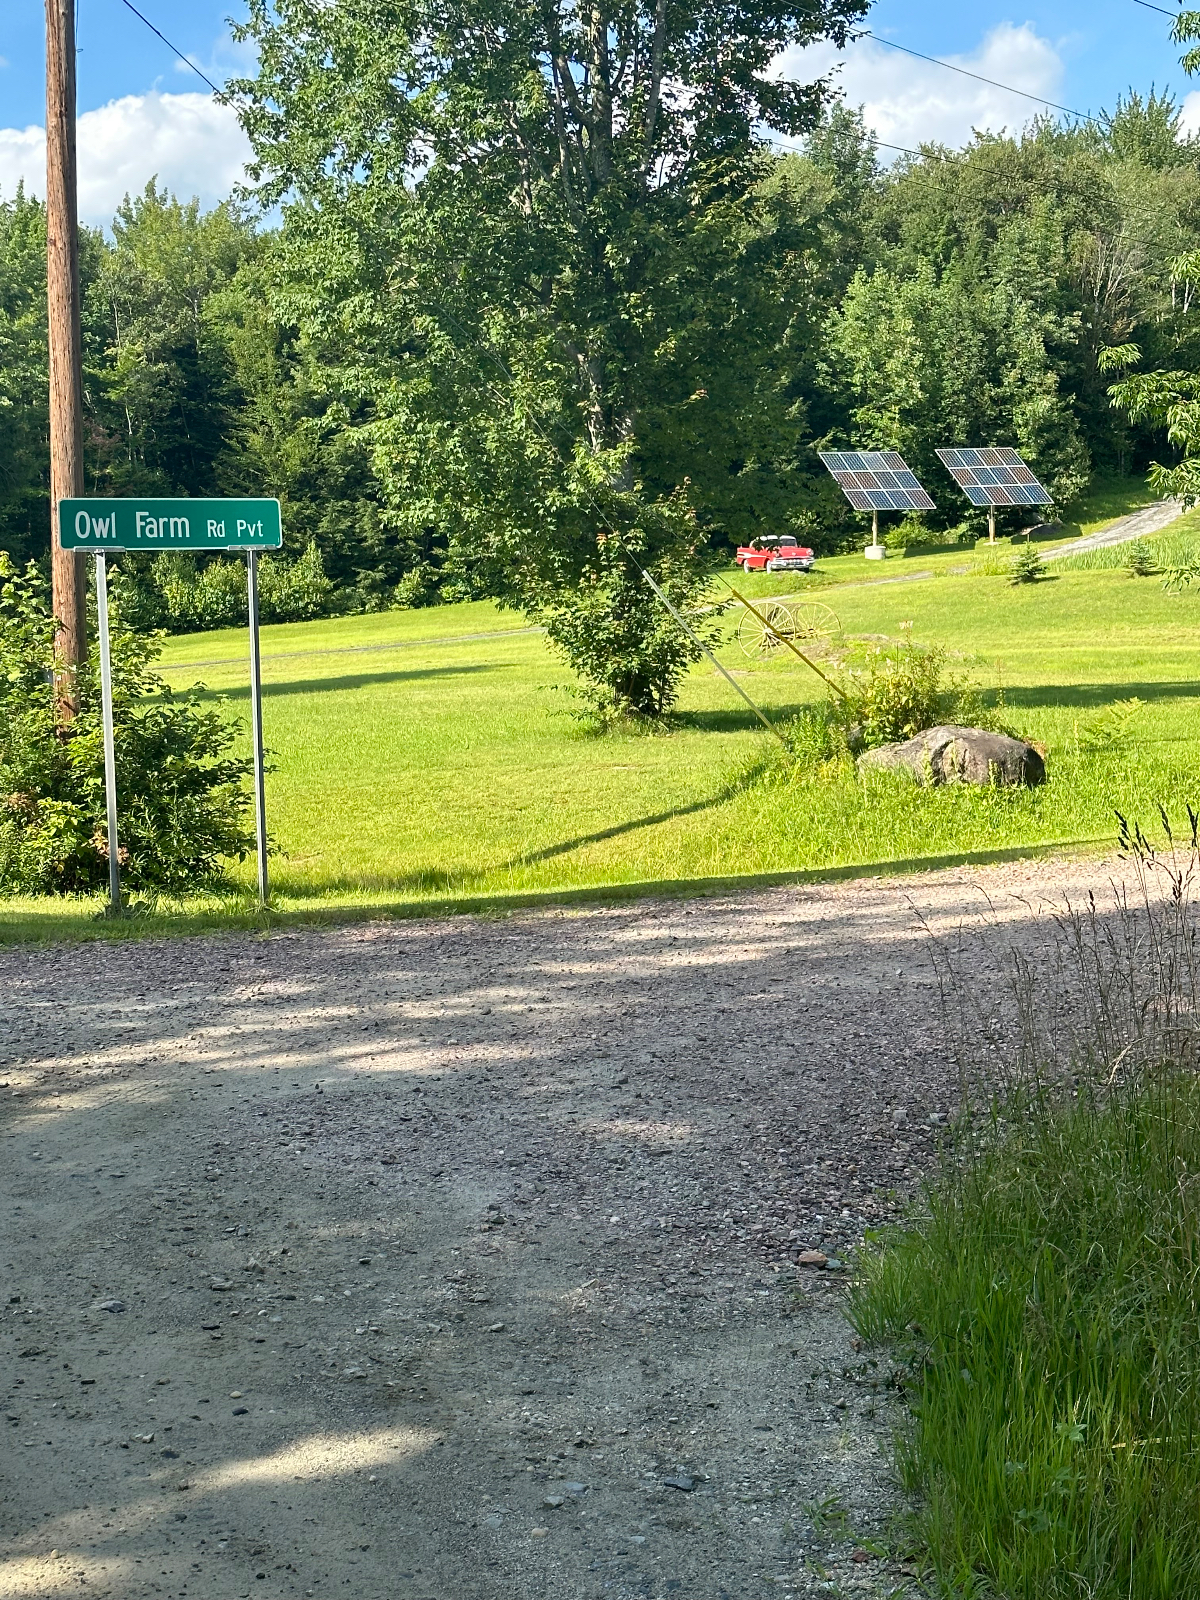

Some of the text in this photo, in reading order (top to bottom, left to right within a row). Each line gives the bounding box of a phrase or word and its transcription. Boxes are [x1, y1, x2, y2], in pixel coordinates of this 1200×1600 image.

[75, 510, 264, 539] Owl Farm Rd Pvt
